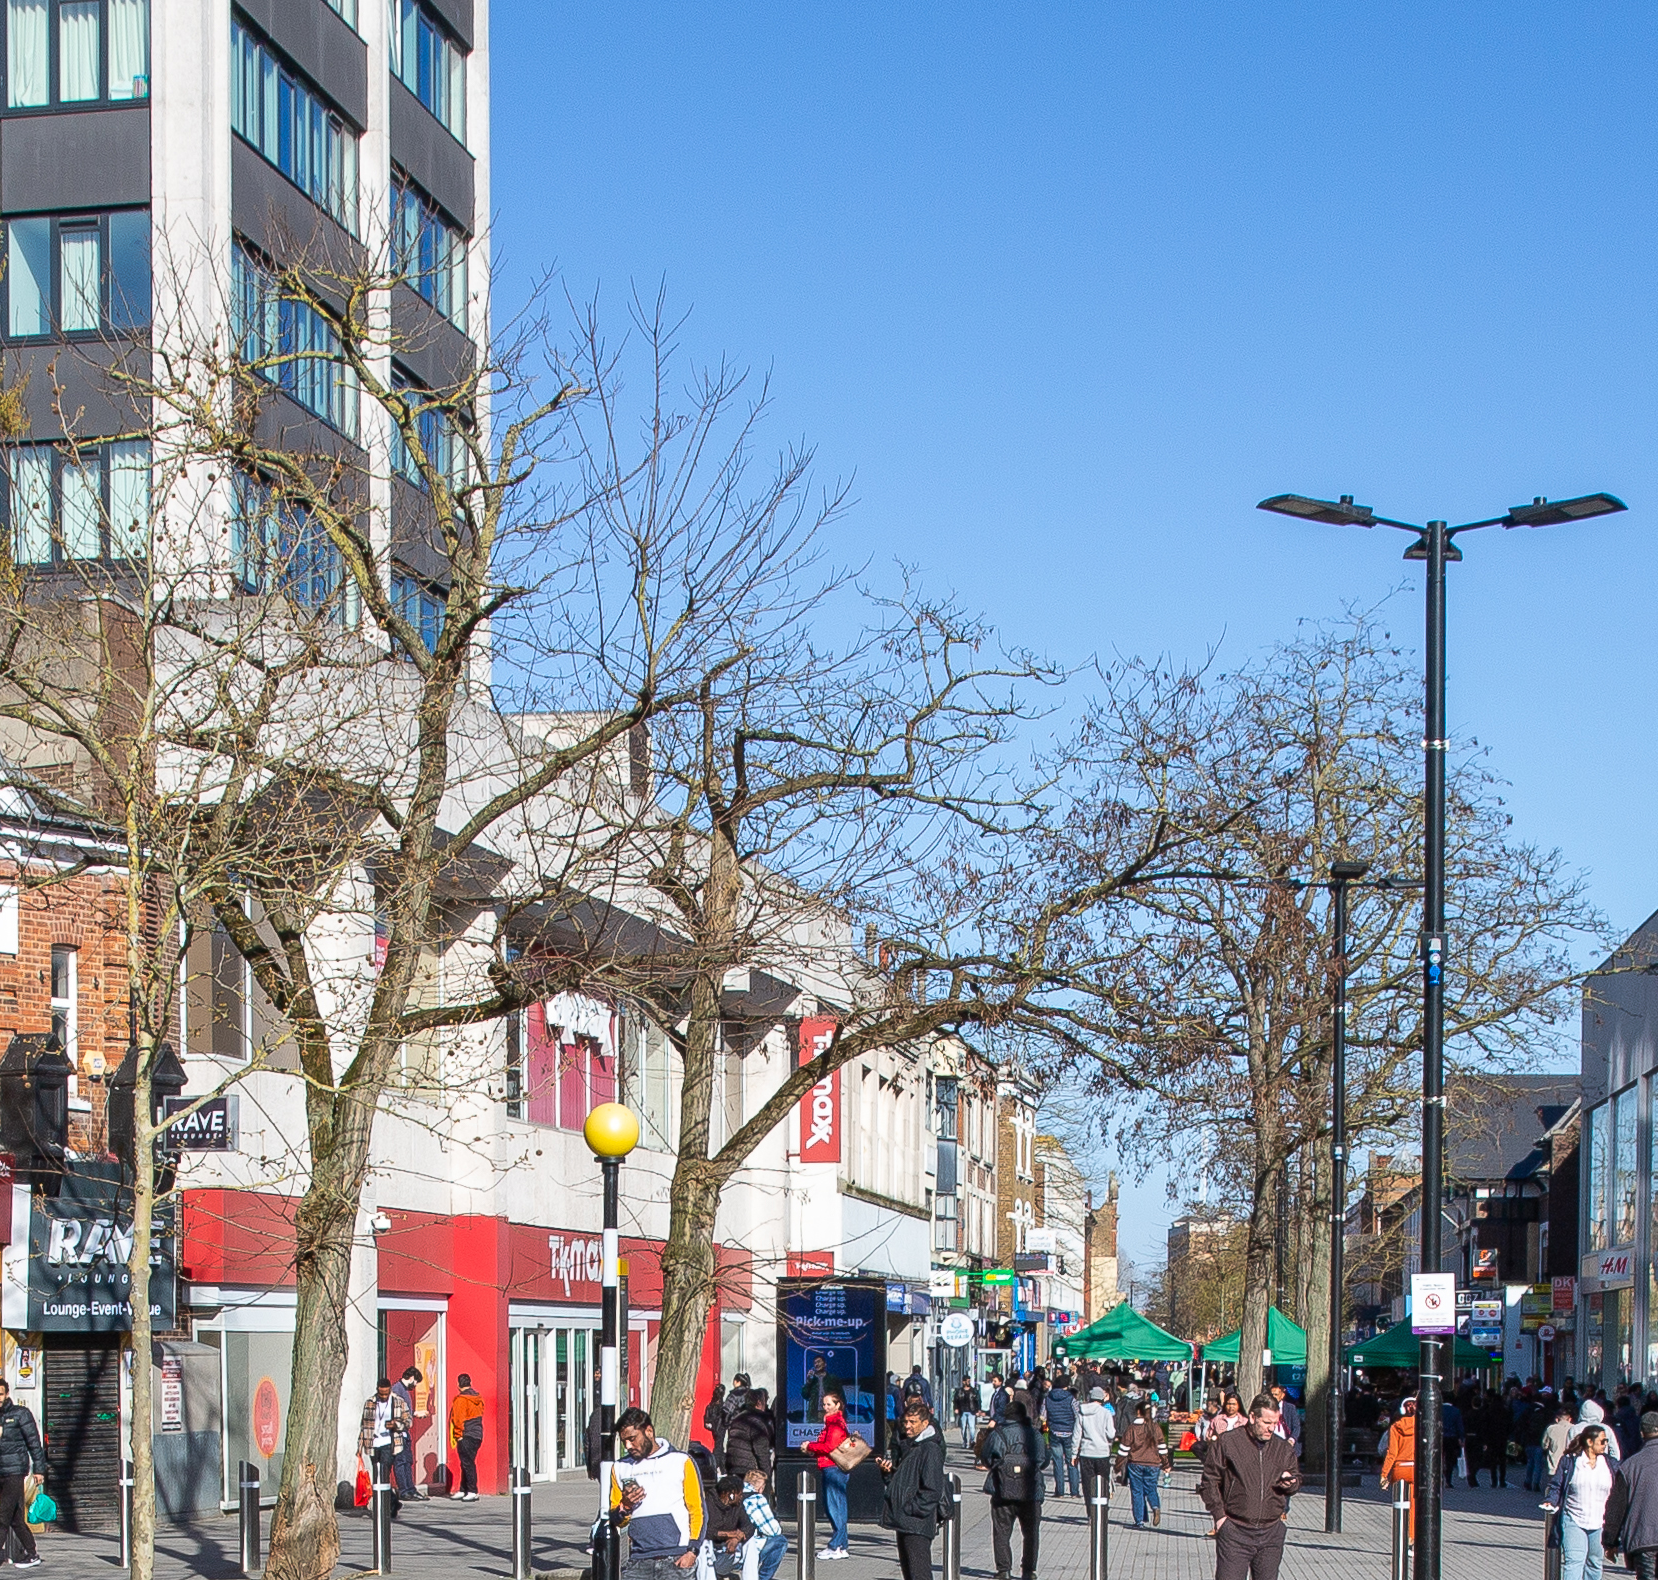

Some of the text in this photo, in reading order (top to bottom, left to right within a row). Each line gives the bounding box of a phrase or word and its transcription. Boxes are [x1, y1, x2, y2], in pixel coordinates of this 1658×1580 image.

[170, 1110, 225, 1132] RAVE
[1601, 1257, 1628, 1274] H&M
[68, 1273, 130, 1284] LOUNG
[1554, 1278, 1572, 1288] DK
[792, 1428, 820, 1437] CHAS
